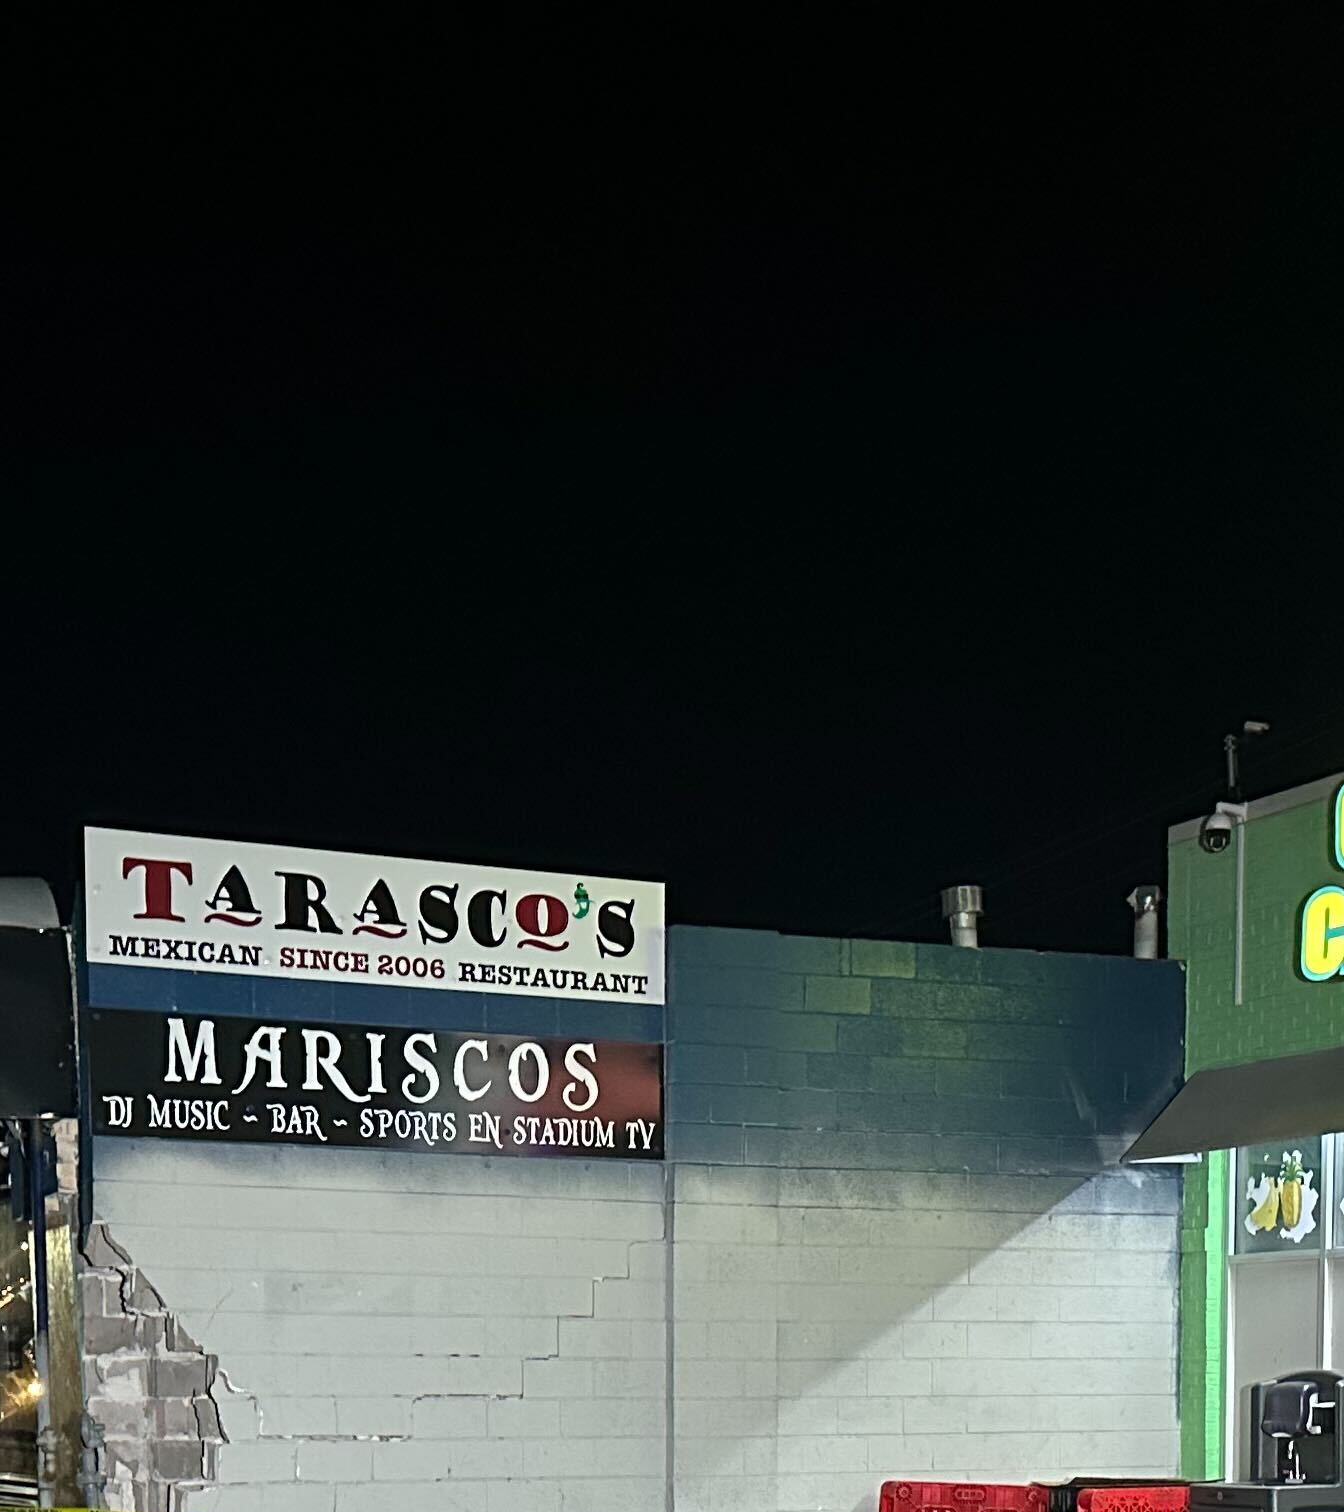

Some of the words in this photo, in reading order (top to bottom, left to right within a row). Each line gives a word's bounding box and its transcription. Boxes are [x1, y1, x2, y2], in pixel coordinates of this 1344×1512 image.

[109, 935, 262, 966] MEXICAN
[280, 947, 369, 973] SINCE
[378, 954, 445, 978] 2006
[459, 962, 648, 994] RESTAURANT
[164, 1018, 599, 1112] MARISCOS
[103, 1095, 133, 1128] DJ
[147, 1094, 230, 1130] MUSIC
[266, 1104, 327, 1141] BAR
[360, 1108, 456, 1146] SPORTS
[469, 1112, 503, 1149] EN
[513, 1116, 615, 1149] STADIUM
[626, 1119, 655, 1150] TV
